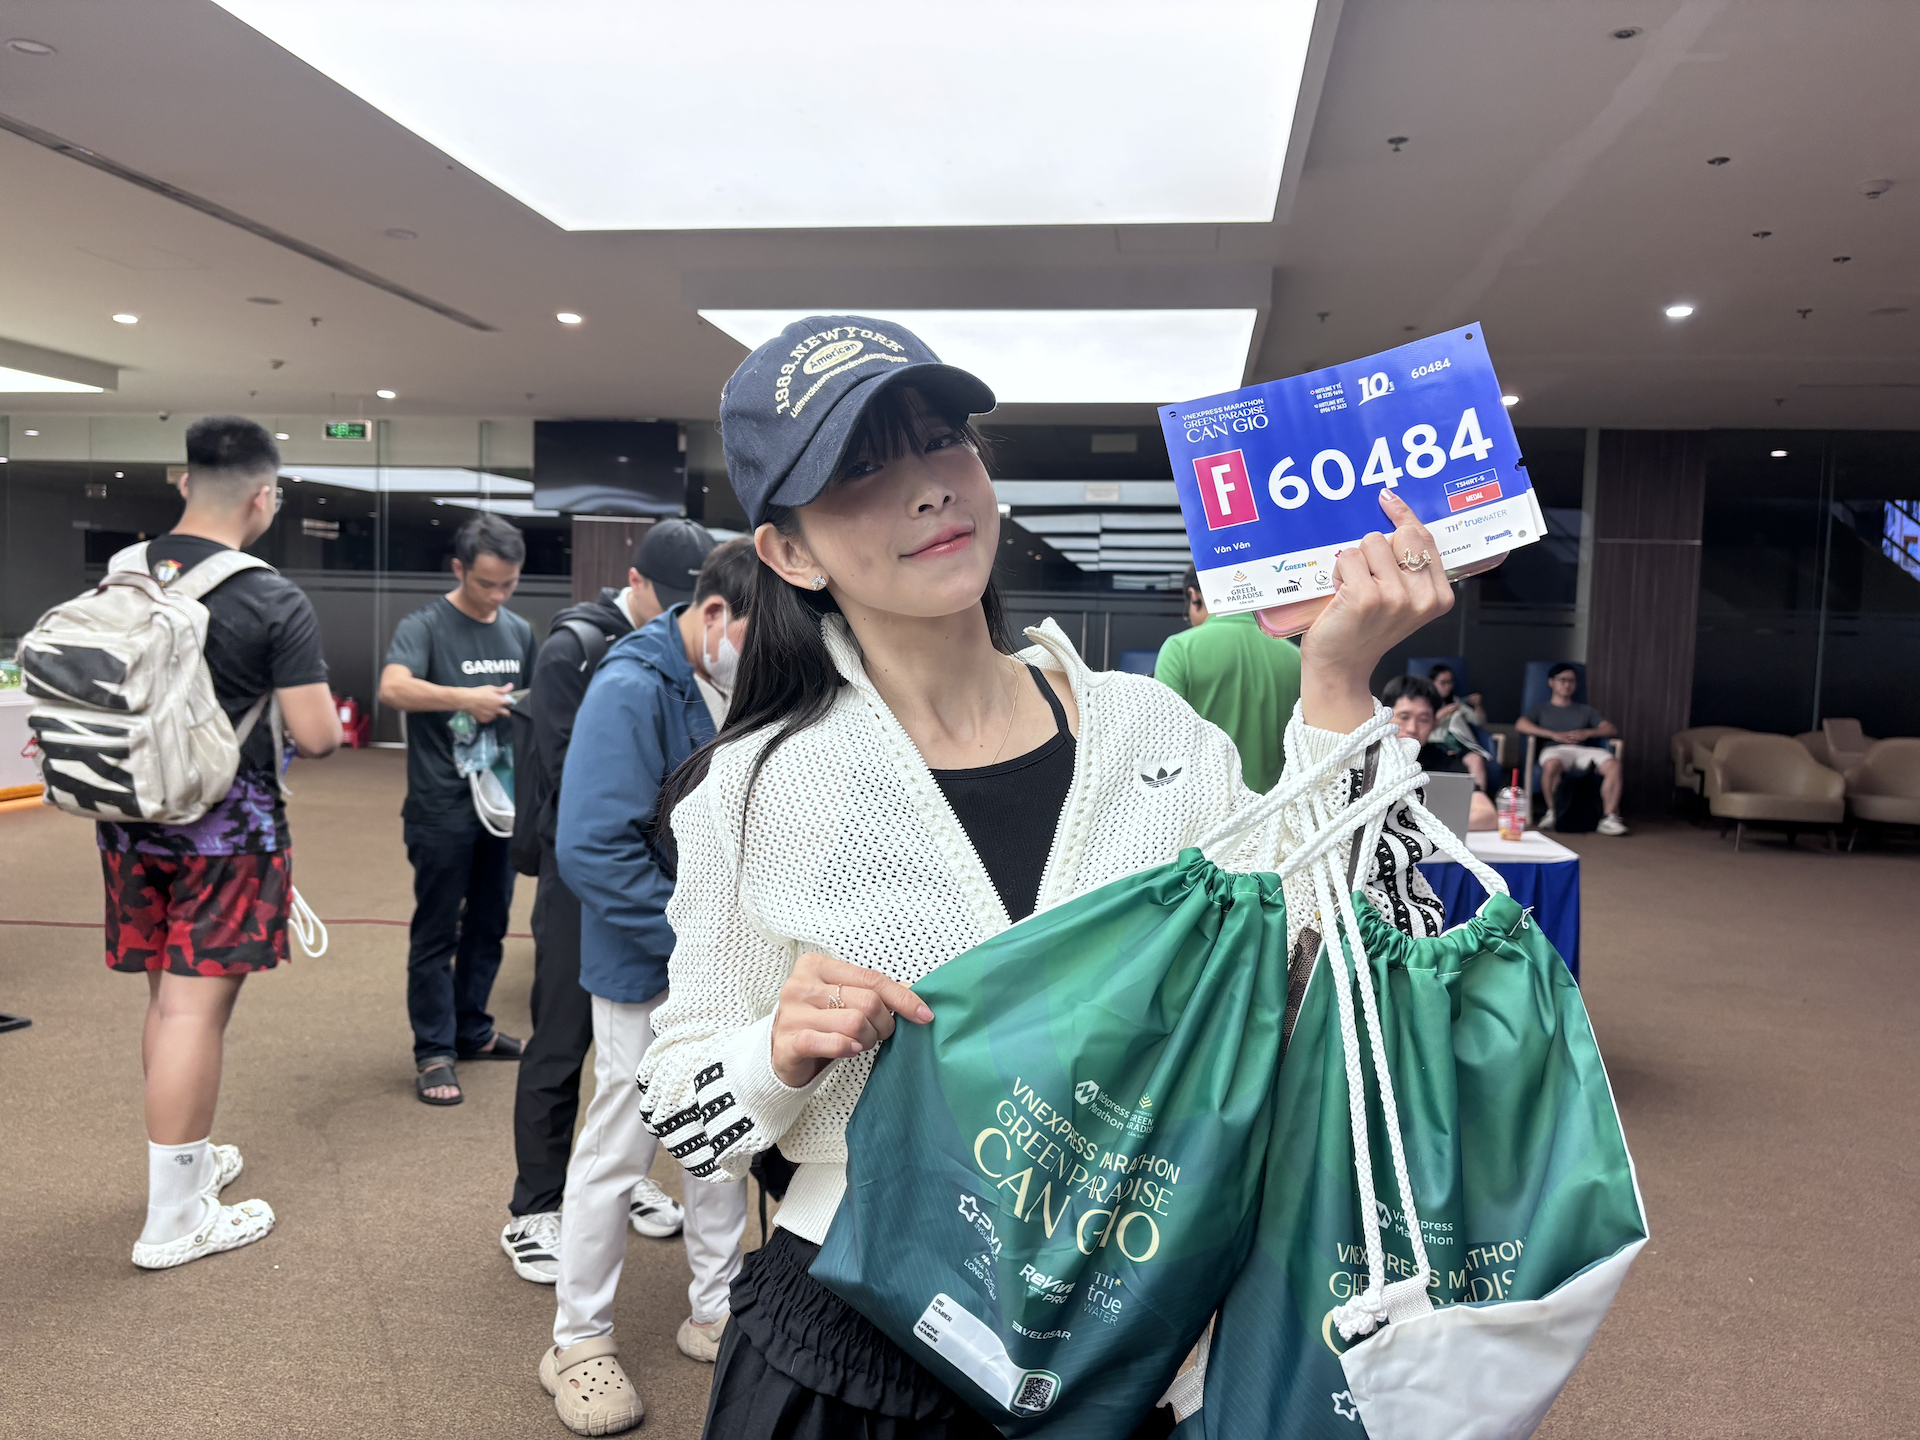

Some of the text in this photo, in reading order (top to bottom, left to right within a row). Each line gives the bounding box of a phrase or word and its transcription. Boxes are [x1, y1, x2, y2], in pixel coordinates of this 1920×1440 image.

[809, 342, 858, 371] American
[1411, 357, 1451, 379] 60484
[1358, 371, 1389, 401] 10
[1182, 398, 1264, 420] VNEXPRESS MARATHON
[1183, 405, 1266, 429] GREEN PARADISE
[1186, 414, 1269, 443] CAN GIO
[1268, 407, 1494, 510] 60484
[1210, 463, 1236, 516] F
[1465, 492, 1484, 503] MEDAL
[1445, 524, 1459, 533] TH
[1485, 529, 1513, 543] Vinamilk
[1284, 562, 1307, 571] GREEN
[1226, 590, 1264, 602] PARADISE
[1231, 586, 1257, 596] GREEN
[1276, 584, 1300, 595] PUMA
[461, 659, 520, 675] GARMIN
[1012, 1076, 1099, 1161] VNEXPRESS
[1088, 1102, 1124, 1131] Marathon
[996, 1099, 1174, 1217] GREEN PARADISE
[974, 1127, 1160, 1263] CAN GIO
[1392, 1209, 1454, 1231] Vnpress
[1395, 1223, 1454, 1246] Mathon
[964, 1258, 985, 1280] LONG
[1095, 1271, 1115, 1291] TH
[1042, 1293, 1068, 1304] PRO
[1087, 1284, 1122, 1314] true
[1083, 1301, 1119, 1326] WATER
[1021, 1327, 1072, 1341] VELOSAR
